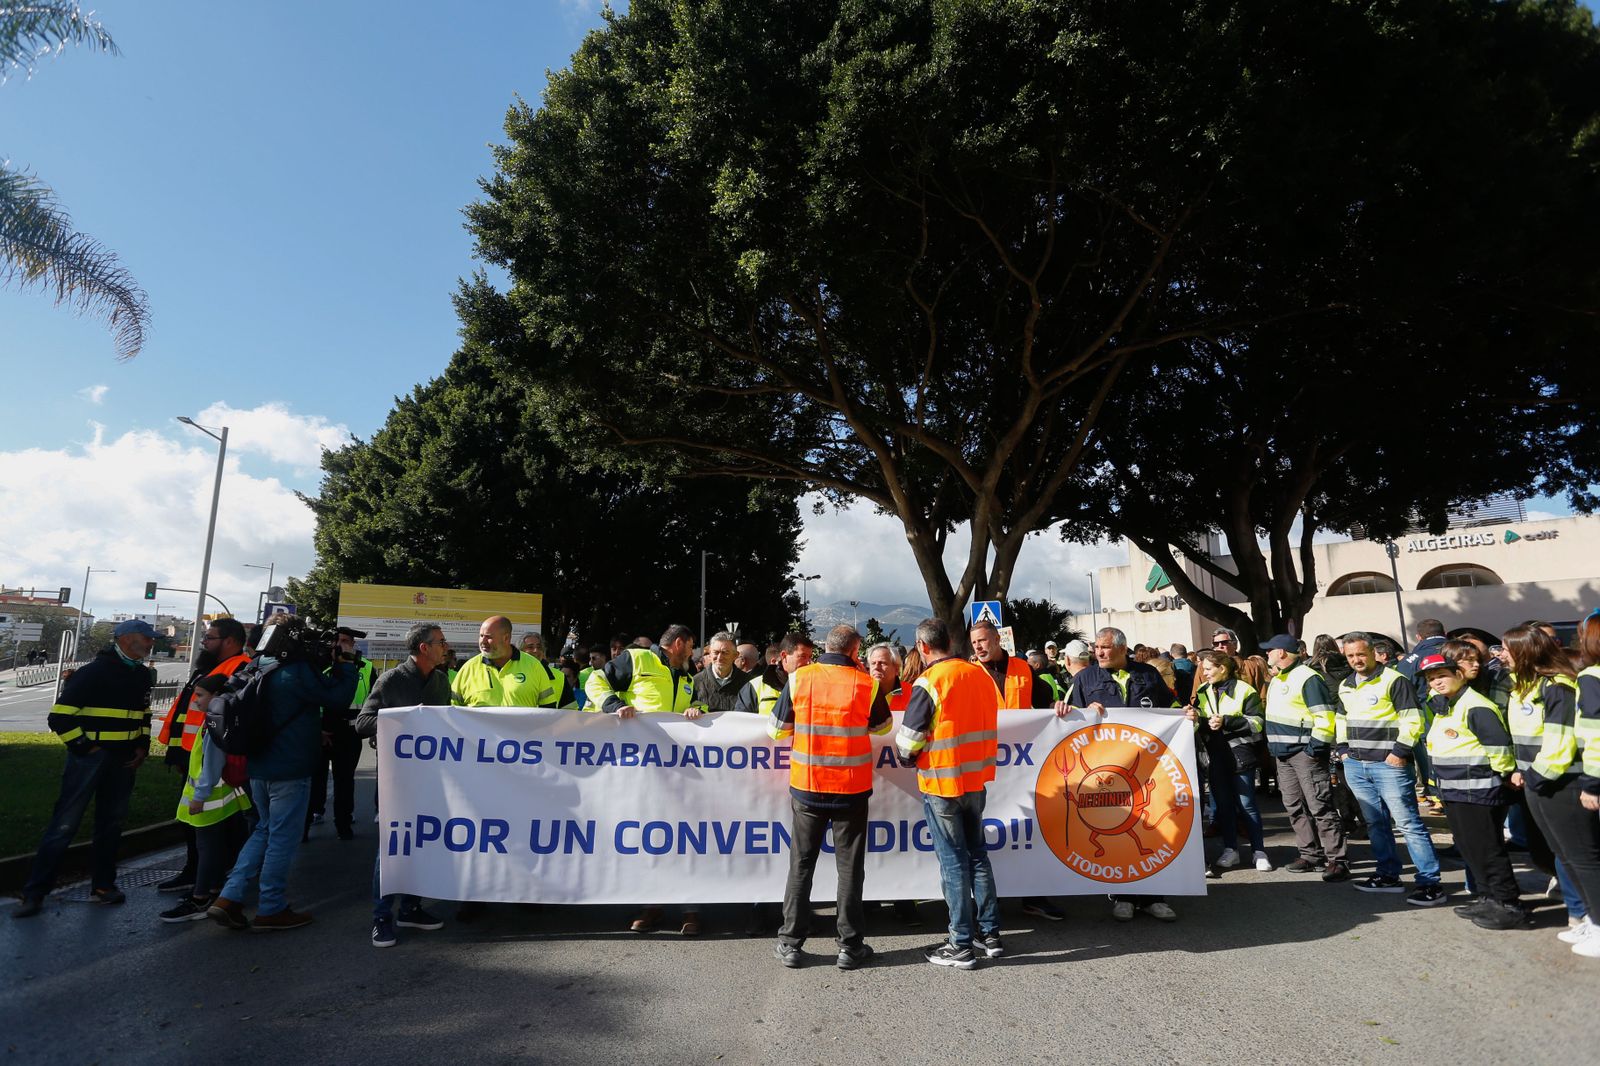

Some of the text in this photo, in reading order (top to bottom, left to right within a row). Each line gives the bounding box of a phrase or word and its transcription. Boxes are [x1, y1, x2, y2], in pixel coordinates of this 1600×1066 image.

[1408, 530, 1560, 553] ALGECIRAS adif
[1135, 594, 1186, 613] adif
[394, 734, 792, 770] CON LOS TRABAJADORE
[1069, 728, 1189, 807] ¡NI UN PASO ATRÁS!
[388, 814, 1033, 857] ¡¡POR UN CONVEN DIGO!!
[1066, 843, 1175, 880] ¡TODOS A UNA!
